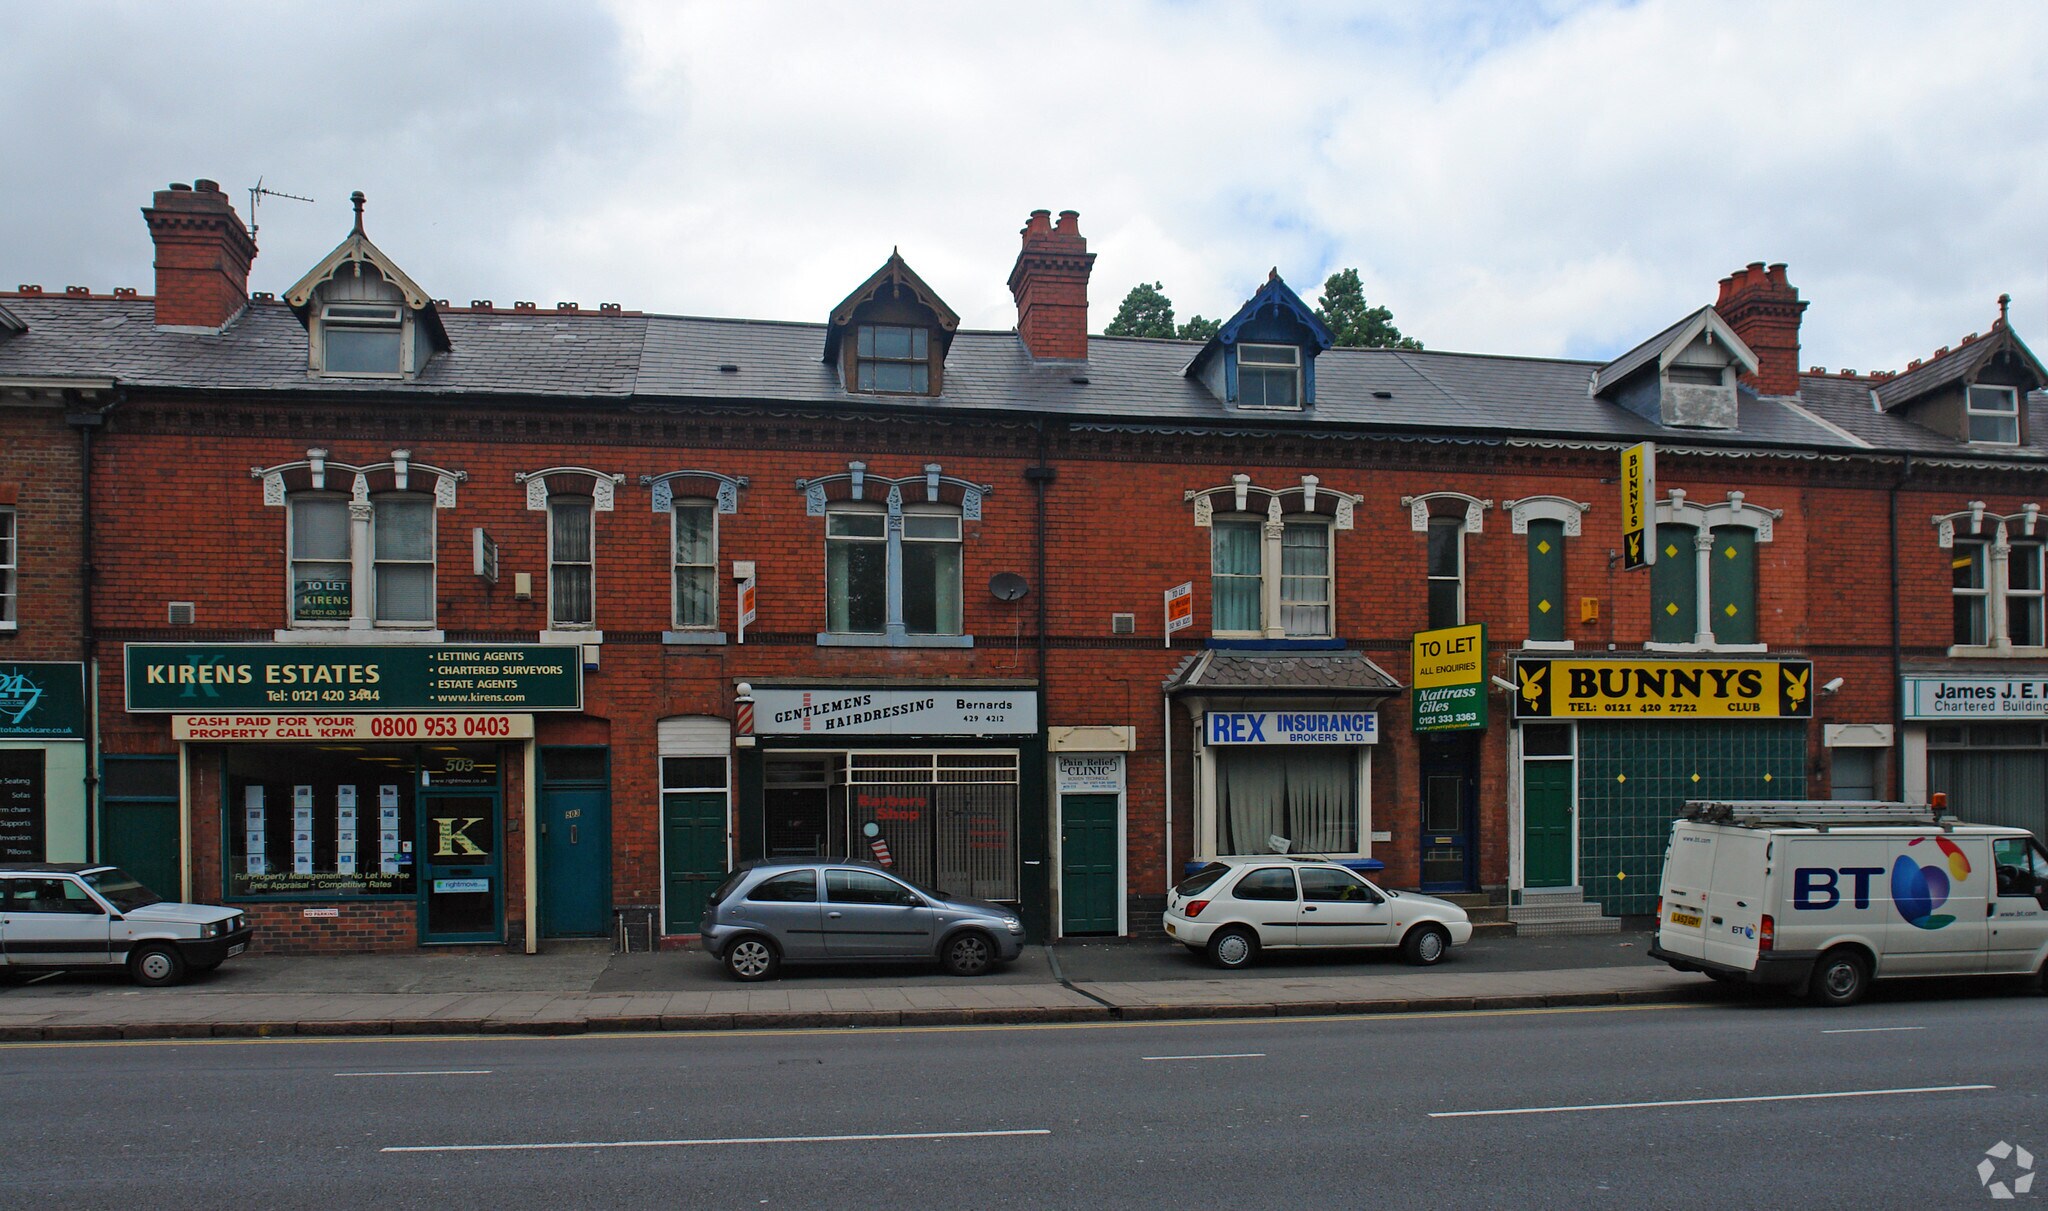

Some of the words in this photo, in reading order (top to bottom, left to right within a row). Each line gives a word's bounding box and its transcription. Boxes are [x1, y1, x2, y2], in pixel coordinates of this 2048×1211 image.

[1630, 454, 1638, 527] BUNNYS
[306, 581, 322, 590] TO
[326, 581, 346, 590] LET
[304, 596, 349, 604] KIRENS
[1420, 641, 1441, 657] TO
[1447, 636, 1475, 654] LET
[438, 652, 480, 661] LETTING
[484, 652, 524, 661] AGENTS
[438, 666, 499, 675] CHARTERED
[502, 666, 563, 675] SURVEYORS
[1436, 662, 1475, 673] ENQUIRIES
[148, 664, 252, 684] KIRENS
[266, 664, 380, 684] ESTATES
[438, 680, 473, 689] ESTATE
[477, 680, 517, 689] AGENTS
[1568, 668, 1762, 698] BUNNYS
[266, 690, 288, 701] Tel:
[292, 691, 318, 701] 0121
[322, 690, 344, 701] 420
[349, 690, 380, 701] 3444
[1419, 688, 1476, 701] Nattrass
[1935, 683, 1996, 699] James
[2001, 683, 2016, 699] J.
[2021, 683, 2038, 698] E.
[438, 693, 525, 702] www.kirens.com
[775, 695, 871, 723] GENTLEMENS
[956, 699, 1012, 710] Bernards
[1419, 701, 1449, 713] Giles
[1568, 703, 1597, 712] TEL:
[1604, 704, 1632, 712] 0121
[1640, 703, 1661, 713] 420
[1669, 703, 1697, 712] 2722
[1727, 703, 1760, 712] CLUB
[1935, 700, 1995, 711] Chartered
[826, 699, 934, 730] HAIRDRESSING
[1419, 716, 1436, 724] 0121
[1438, 714, 1453, 723] 333
[1455, 712, 1476, 721] 3363
[187, 717, 230, 726] CASH
[236, 717, 271, 726] PAID
[277, 717, 307, 726] FOR
[312, 717, 354, 726] YOUR
[371, 717, 417, 736] 0800
[424, 717, 457, 736] 953
[463, 717, 510, 736] 0403
[1277, 714, 1374, 732] INSURANCE
[190, 729, 267, 738] PROPERTY
[276, 729, 312, 737] CALL
[318, 729, 356, 737] 'KPM'
[1213, 714, 1266, 742] REX
[1290, 734, 1338, 742] BROKERS
[1344, 734, 1365, 742] LTD.
[445, 759, 474, 772] 503
[1068, 766, 1109, 775] CLINIC
[858, 794, 926, 807] Barbers
[876, 808, 920, 822] Shop
[432, 818, 488, 856] K
[251, 873, 286, 882] Property
[289, 873, 341, 881] Management
[271, 881, 309, 889] Appraisal
[318, 881, 366, 889] Competitive
[1794, 867, 1885, 910] BT
[1732, 926, 1744, 934] BT
